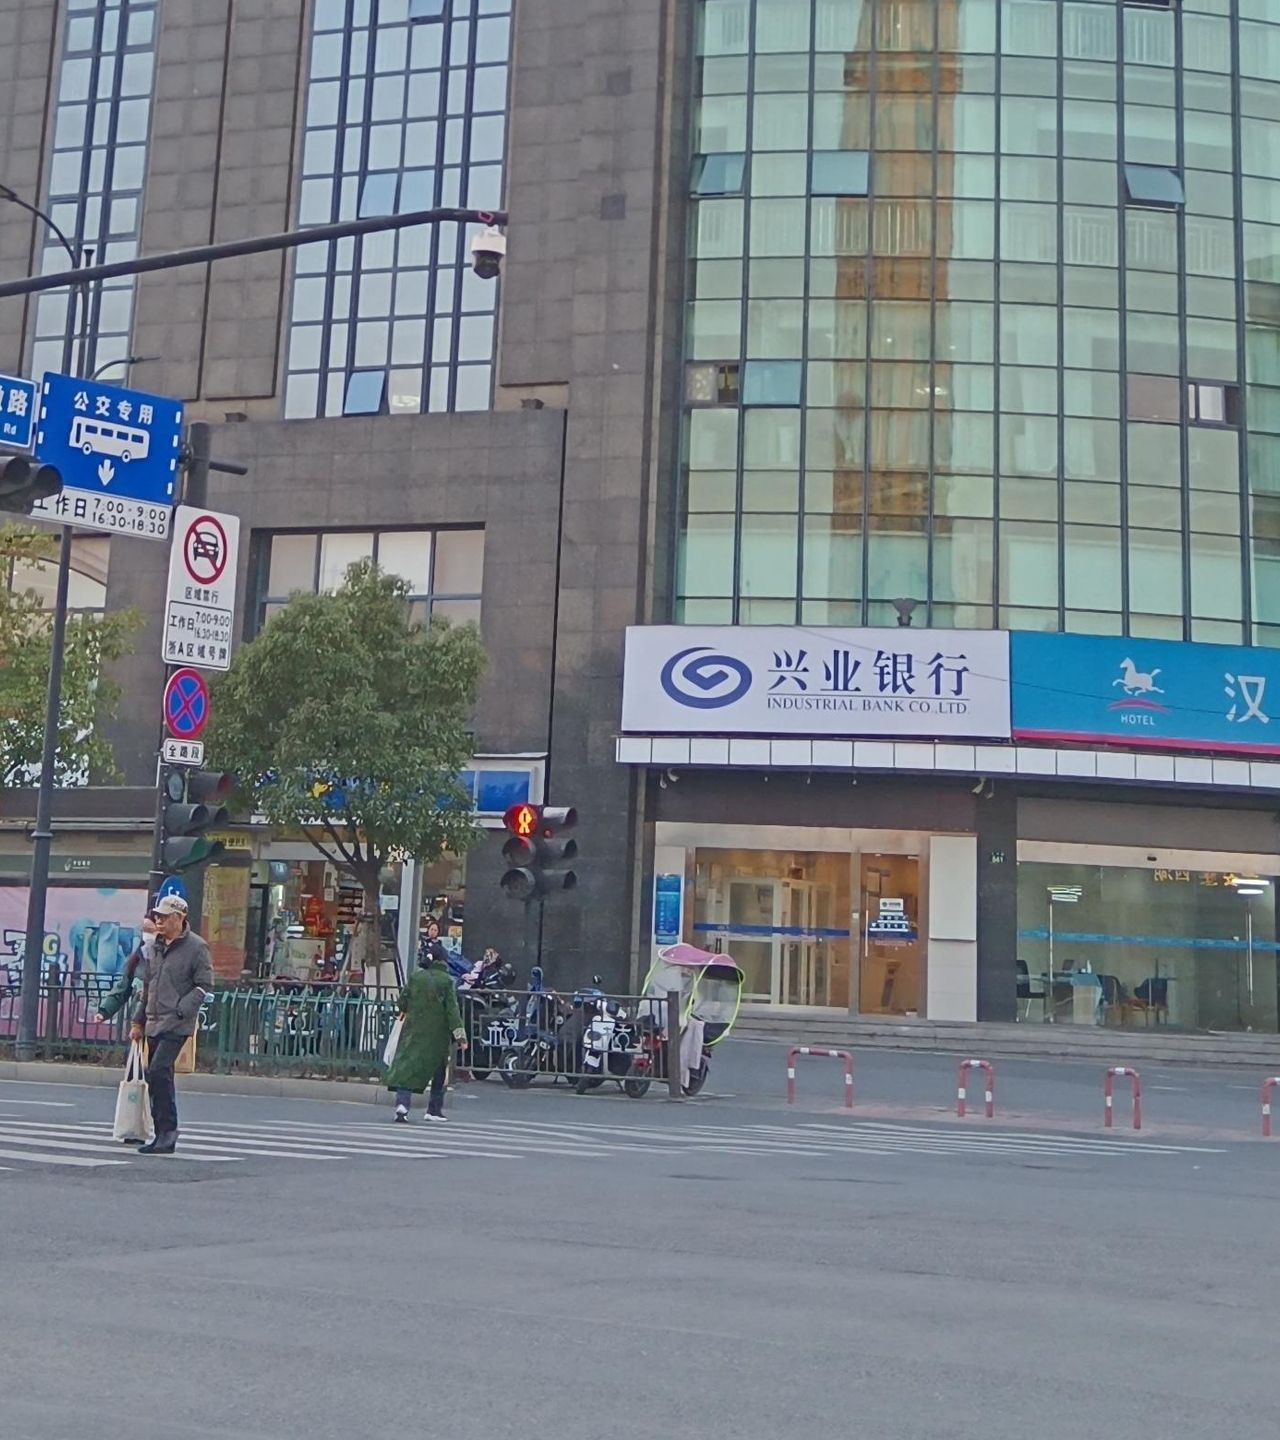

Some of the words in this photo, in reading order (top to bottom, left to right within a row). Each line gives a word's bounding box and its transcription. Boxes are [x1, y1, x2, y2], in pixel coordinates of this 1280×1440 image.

[74, 391, 154, 425] 公交专用
[4, 422, 17, 436] Rd
[92, 512, 166, 535] 16:30-18:30
[169, 614, 194, 631] 工作日
[767, 649, 970, 696] 兴业银行
[767, 697, 859, 711] INDUSTRIAL
[862, 699, 905, 713] BANK
[1121, 713, 1155, 726] HOTEL
[169, 744, 199, 760] 全路段
